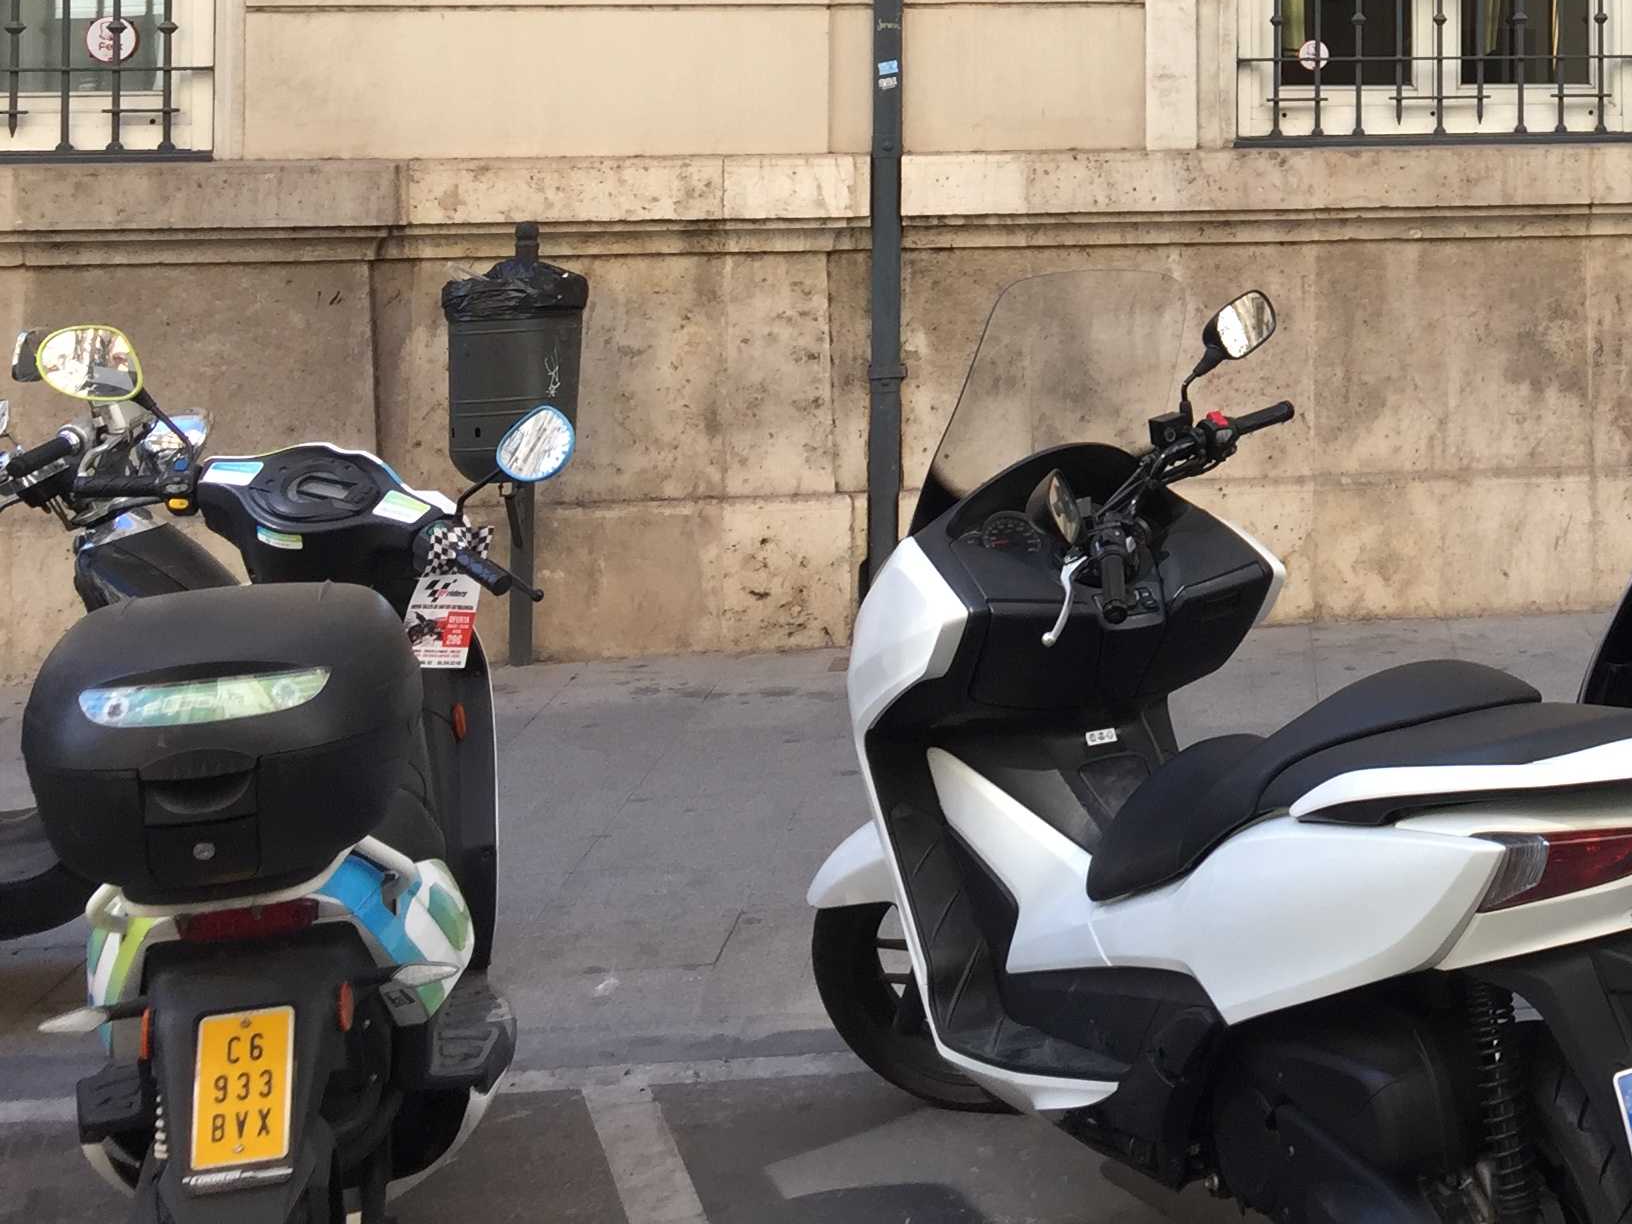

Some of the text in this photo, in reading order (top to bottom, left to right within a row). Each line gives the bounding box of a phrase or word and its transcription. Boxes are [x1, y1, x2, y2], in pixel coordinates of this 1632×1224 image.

[226, 1032, 264, 1064] C6
[214, 1069, 273, 1104] 933
[211, 1107, 271, 1143] BVX
